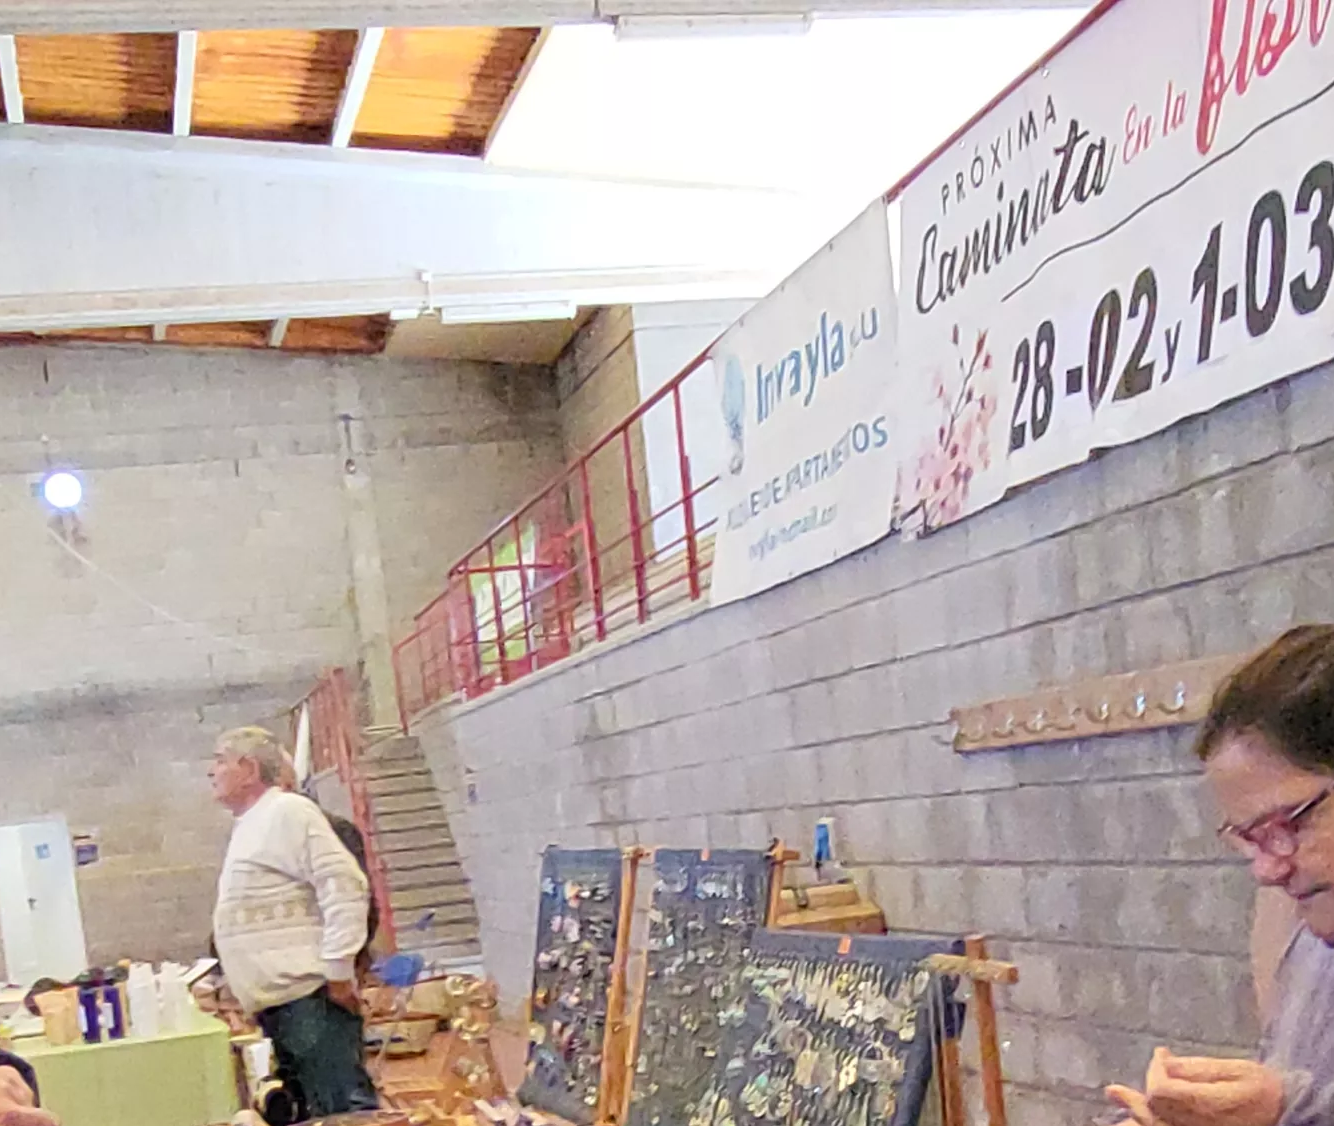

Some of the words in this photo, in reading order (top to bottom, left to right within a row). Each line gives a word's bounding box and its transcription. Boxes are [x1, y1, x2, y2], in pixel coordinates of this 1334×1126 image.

[916, 118, 1117, 315] Caminata
[1122, 103, 1153, 165] En
[1162, 79, 1187, 137] la
[941, 94, 1057, 216] PRÓXIMA
